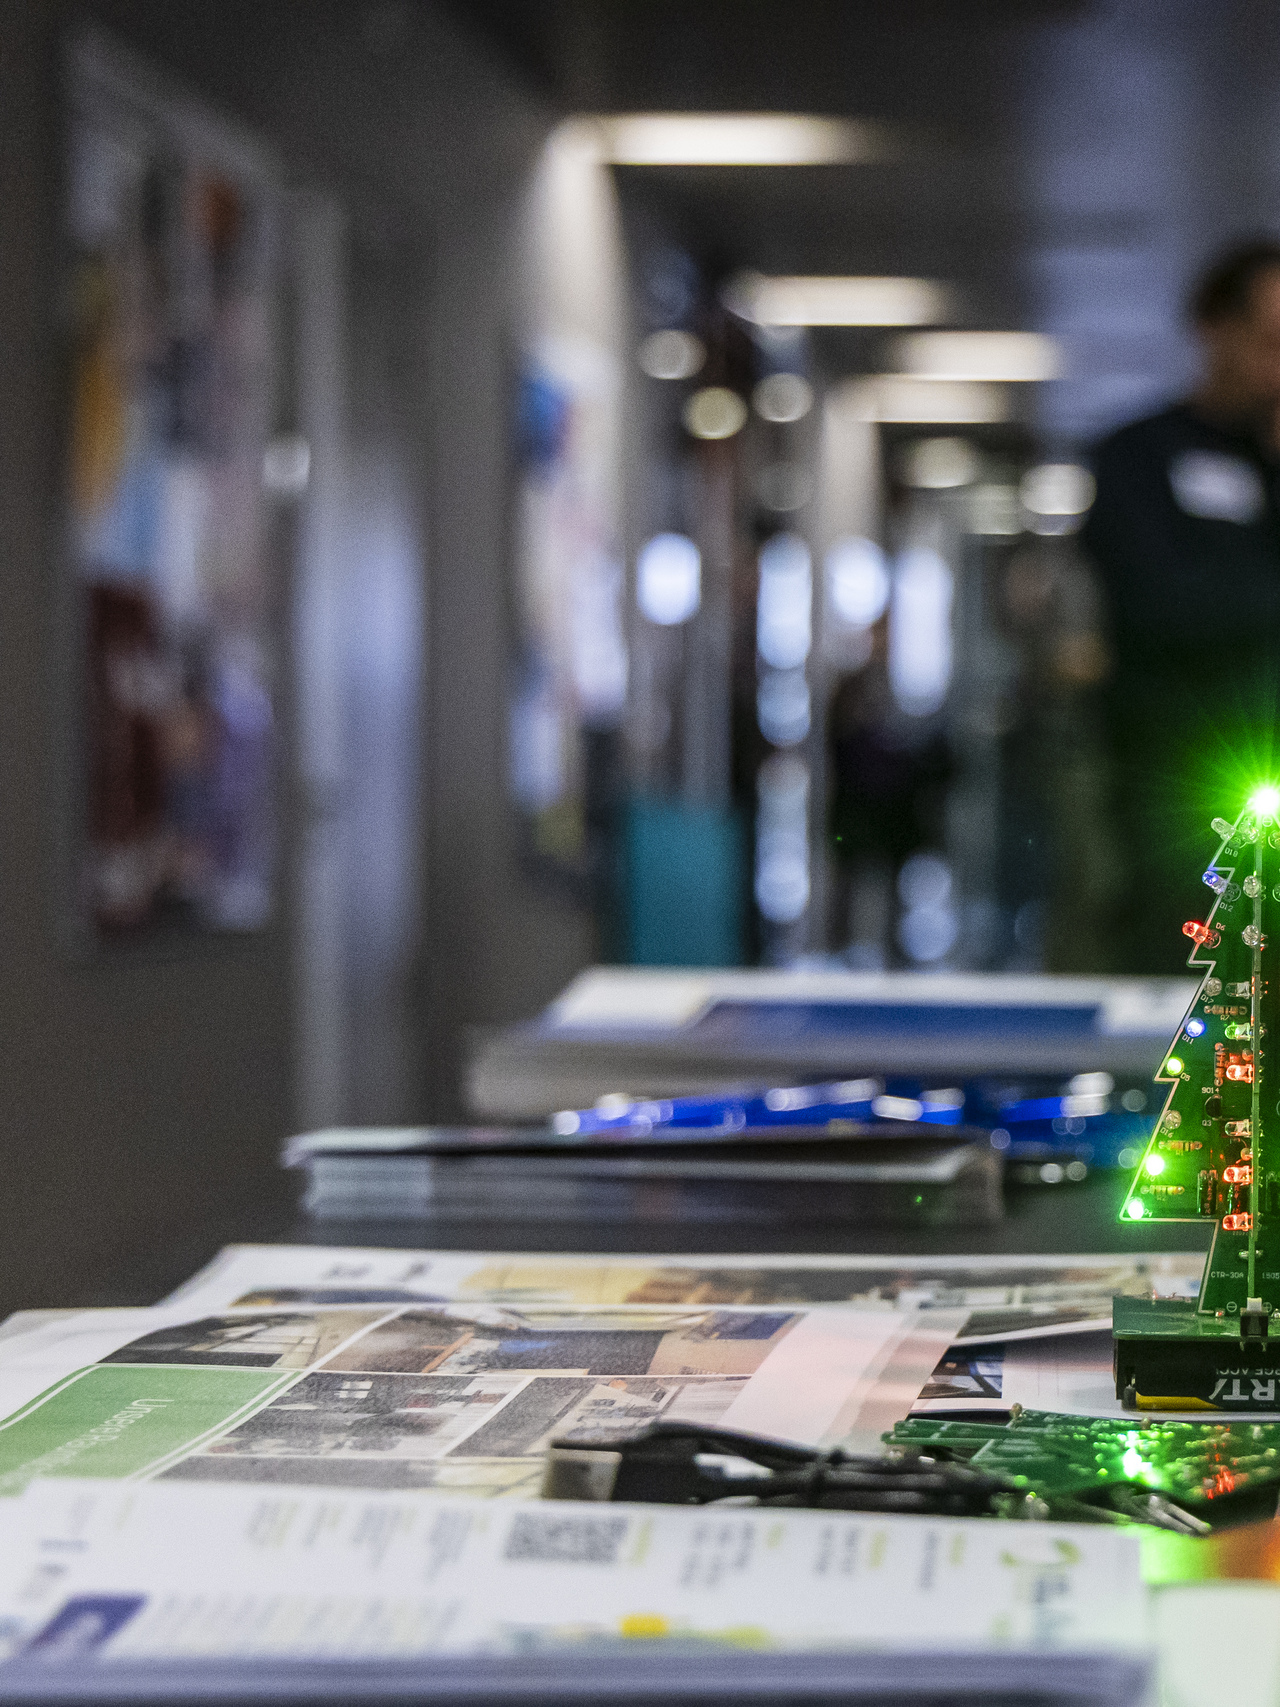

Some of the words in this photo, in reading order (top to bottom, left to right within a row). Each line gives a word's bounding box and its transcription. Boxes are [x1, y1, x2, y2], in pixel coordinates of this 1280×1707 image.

[1224, 847, 1239, 858] D18
[1219, 901, 1234, 912] D12
[1215, 922, 1226, 931] D6
[1200, 994, 1214, 1004] D17
[1181, 1033, 1194, 1045] D11
[1160, 1127, 1174, 1138] D16
